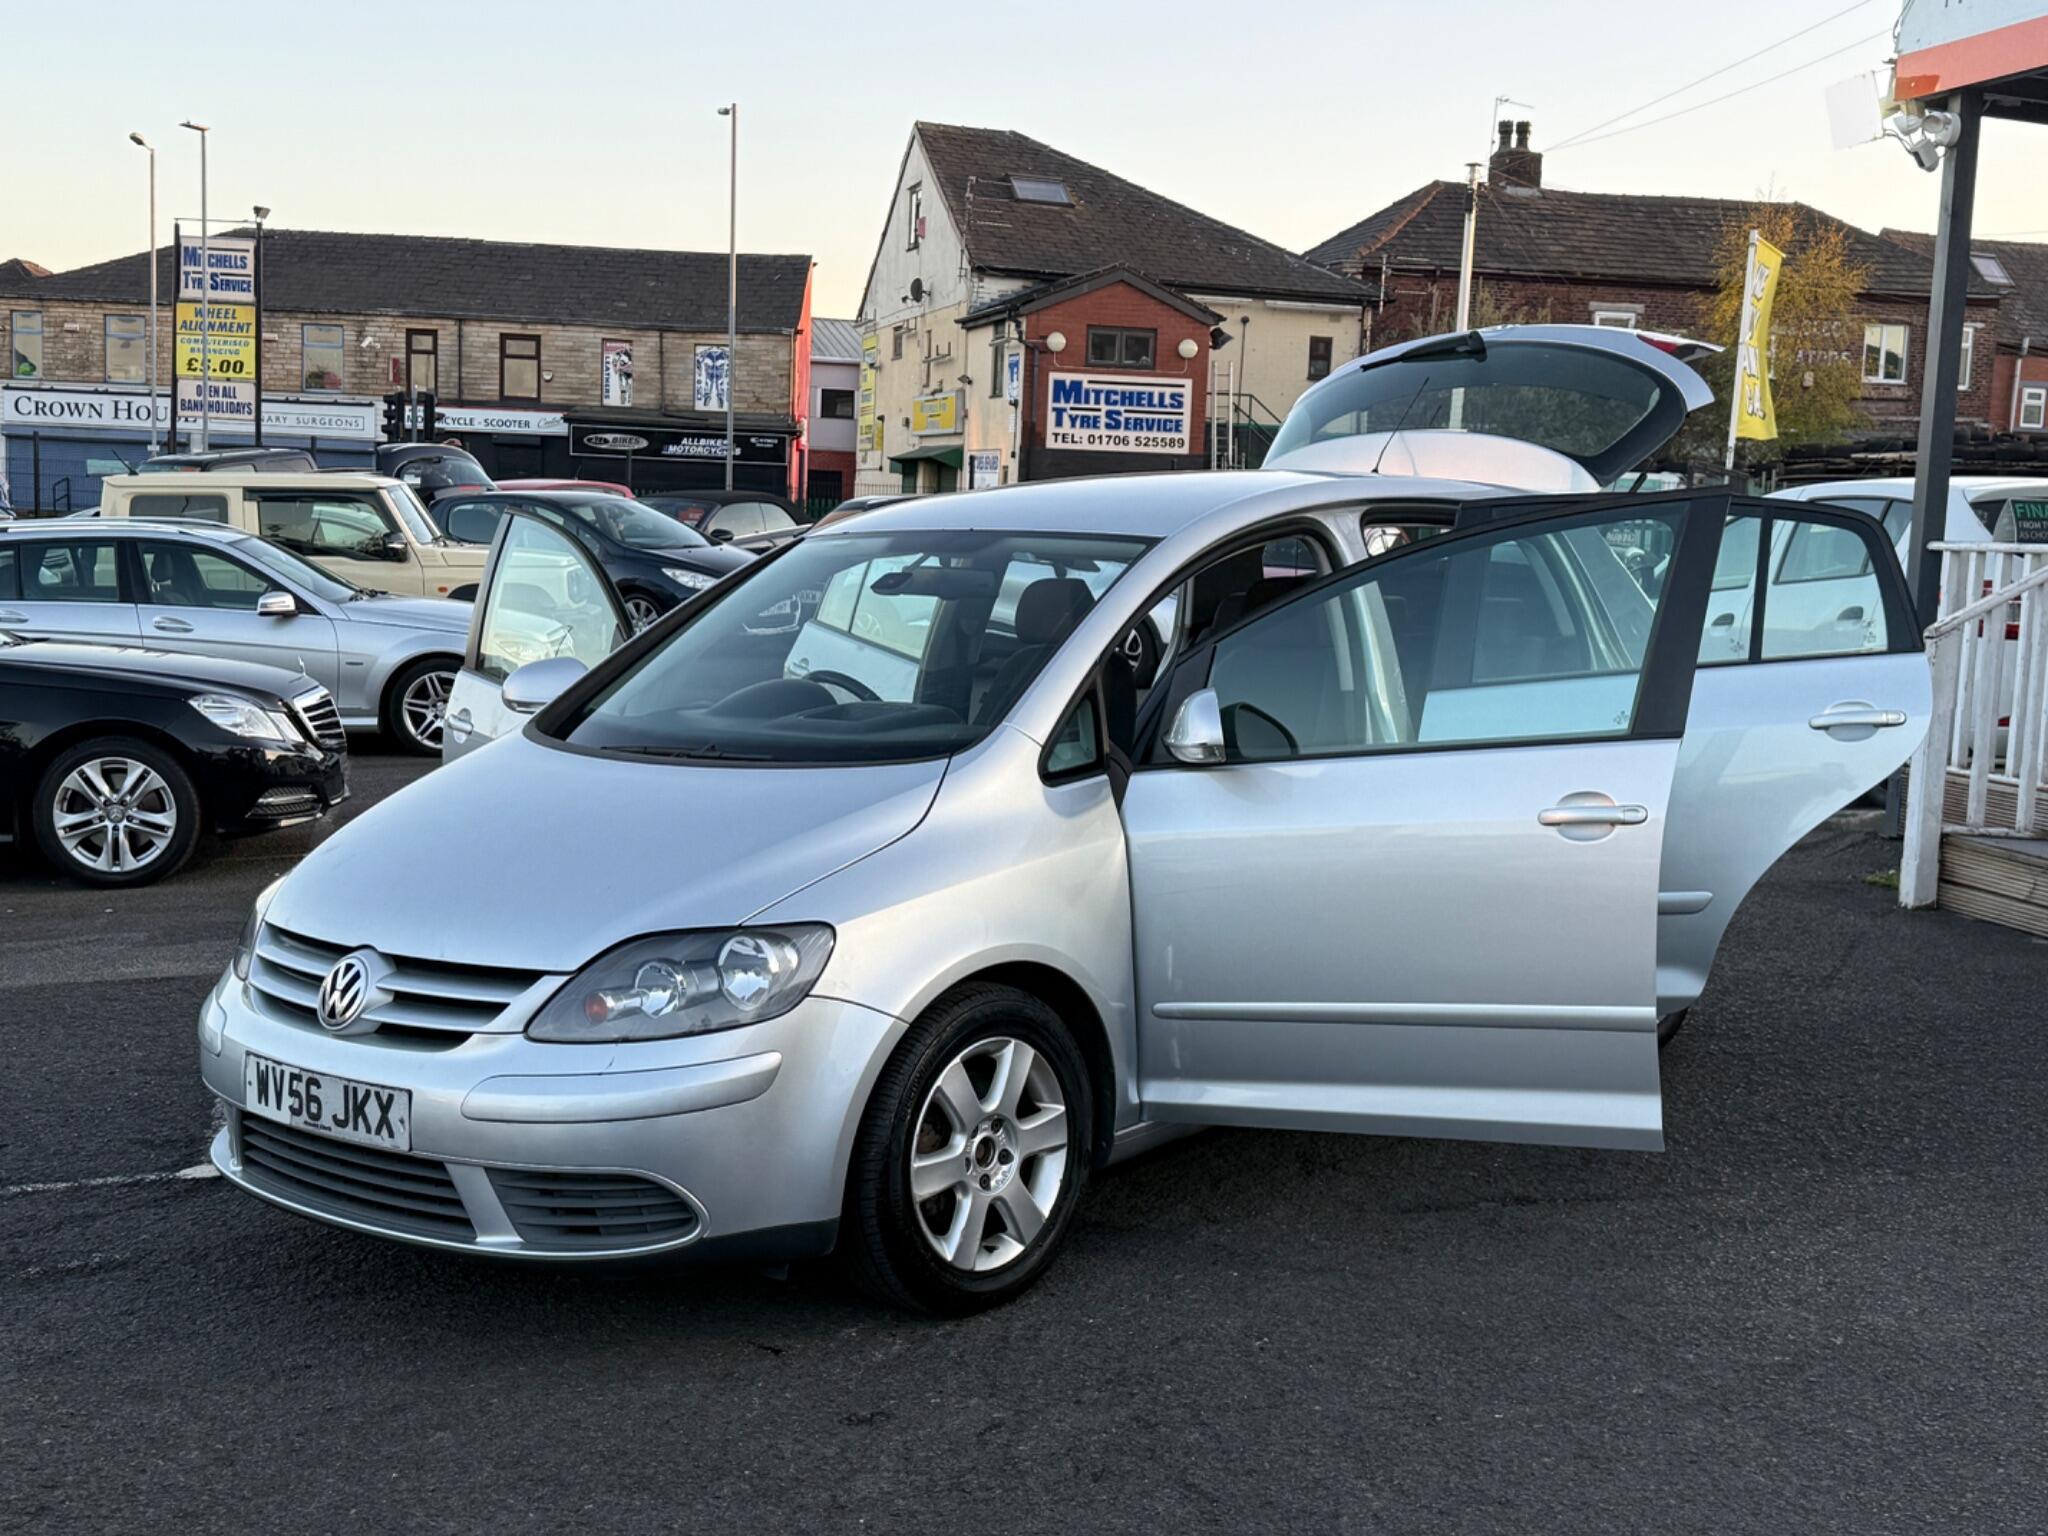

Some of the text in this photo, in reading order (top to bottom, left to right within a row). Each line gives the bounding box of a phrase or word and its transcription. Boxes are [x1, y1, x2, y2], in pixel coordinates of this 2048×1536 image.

[183, 246, 248, 269] MICHELLS
[183, 271, 252, 293] TYR SERVICE
[180, 337, 250, 348] COMTERISED
[189, 347, 241, 356] BAANCING
[196, 384, 237, 400] OEN ALL
[1052, 379, 1184, 409] MITCHELLS
[14, 395, 197, 423] CROWN HOU
[208, 400, 253, 415] HOLIDAYS
[296, 416, 360, 428] SURGEONS
[484, 418, 530, 429] SCOOTER
[1052, 407, 1183, 433] TYRE SERVICE
[1052, 432, 1185, 449] TEL: 01706 525589
[256, 1061, 395, 1139] WV56 JKX
